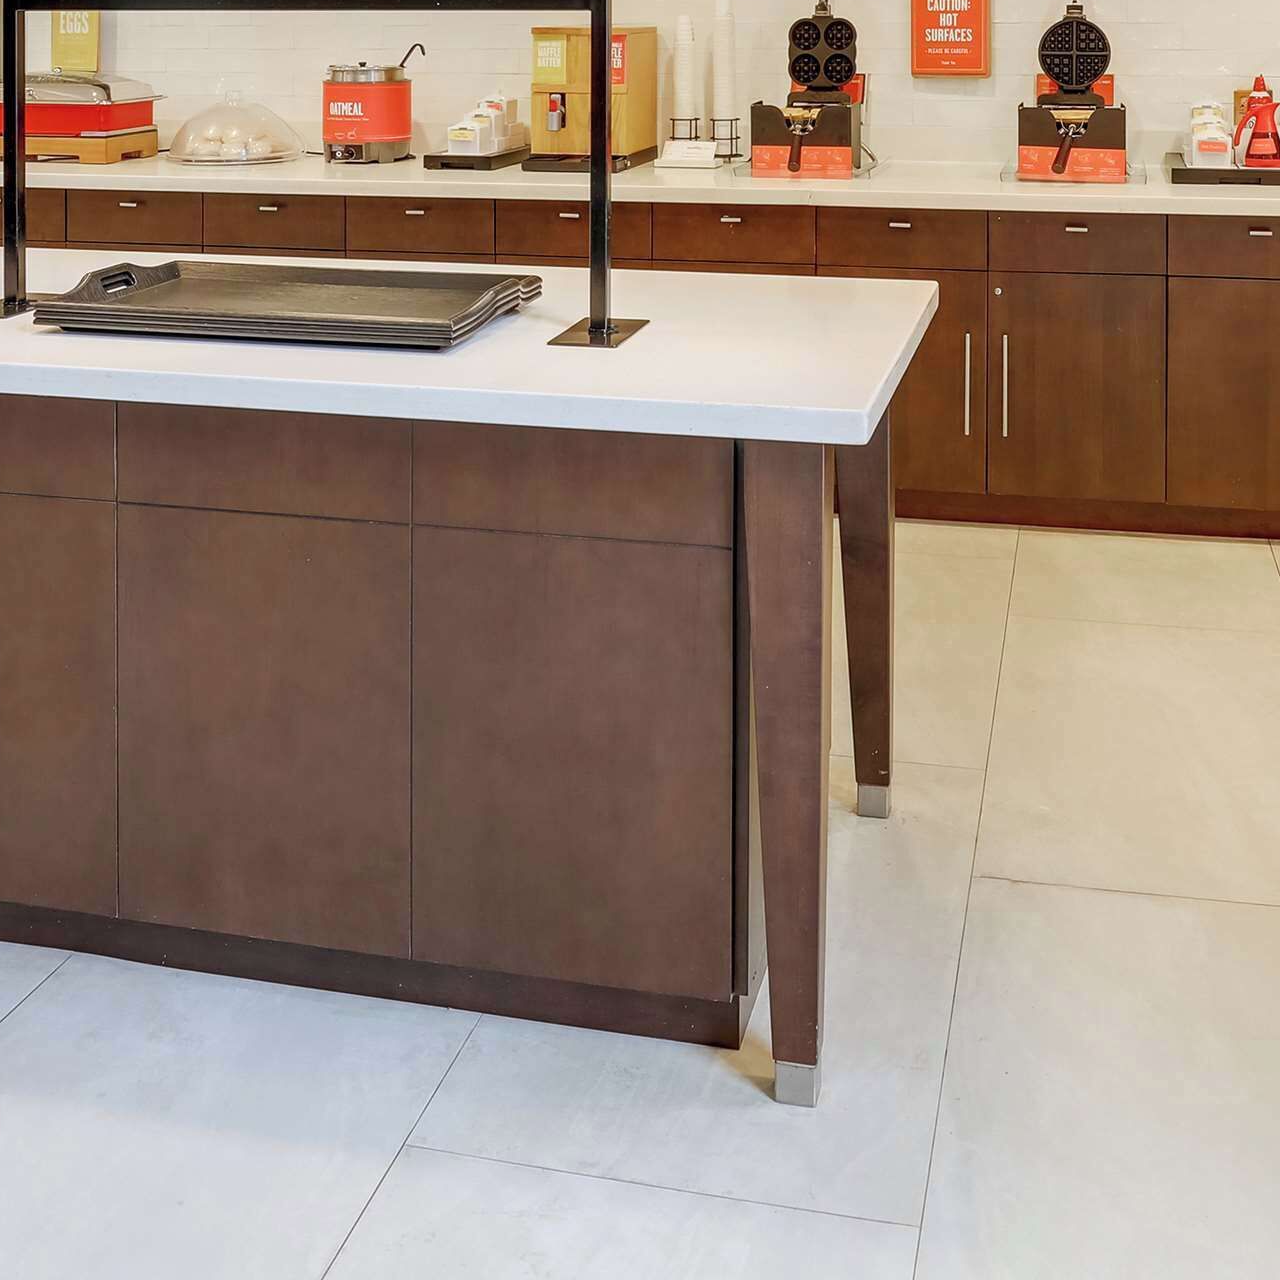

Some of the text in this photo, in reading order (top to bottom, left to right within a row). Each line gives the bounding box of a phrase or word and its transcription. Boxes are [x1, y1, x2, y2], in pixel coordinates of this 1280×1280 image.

[60, 11, 89, 34] EGGS
[939, 13, 959, 27] HOT
[925, 28, 973, 42] SURFACES
[537, 47, 561, 57] WAFFLE
[329, 102, 364, 116] OATMEAL
